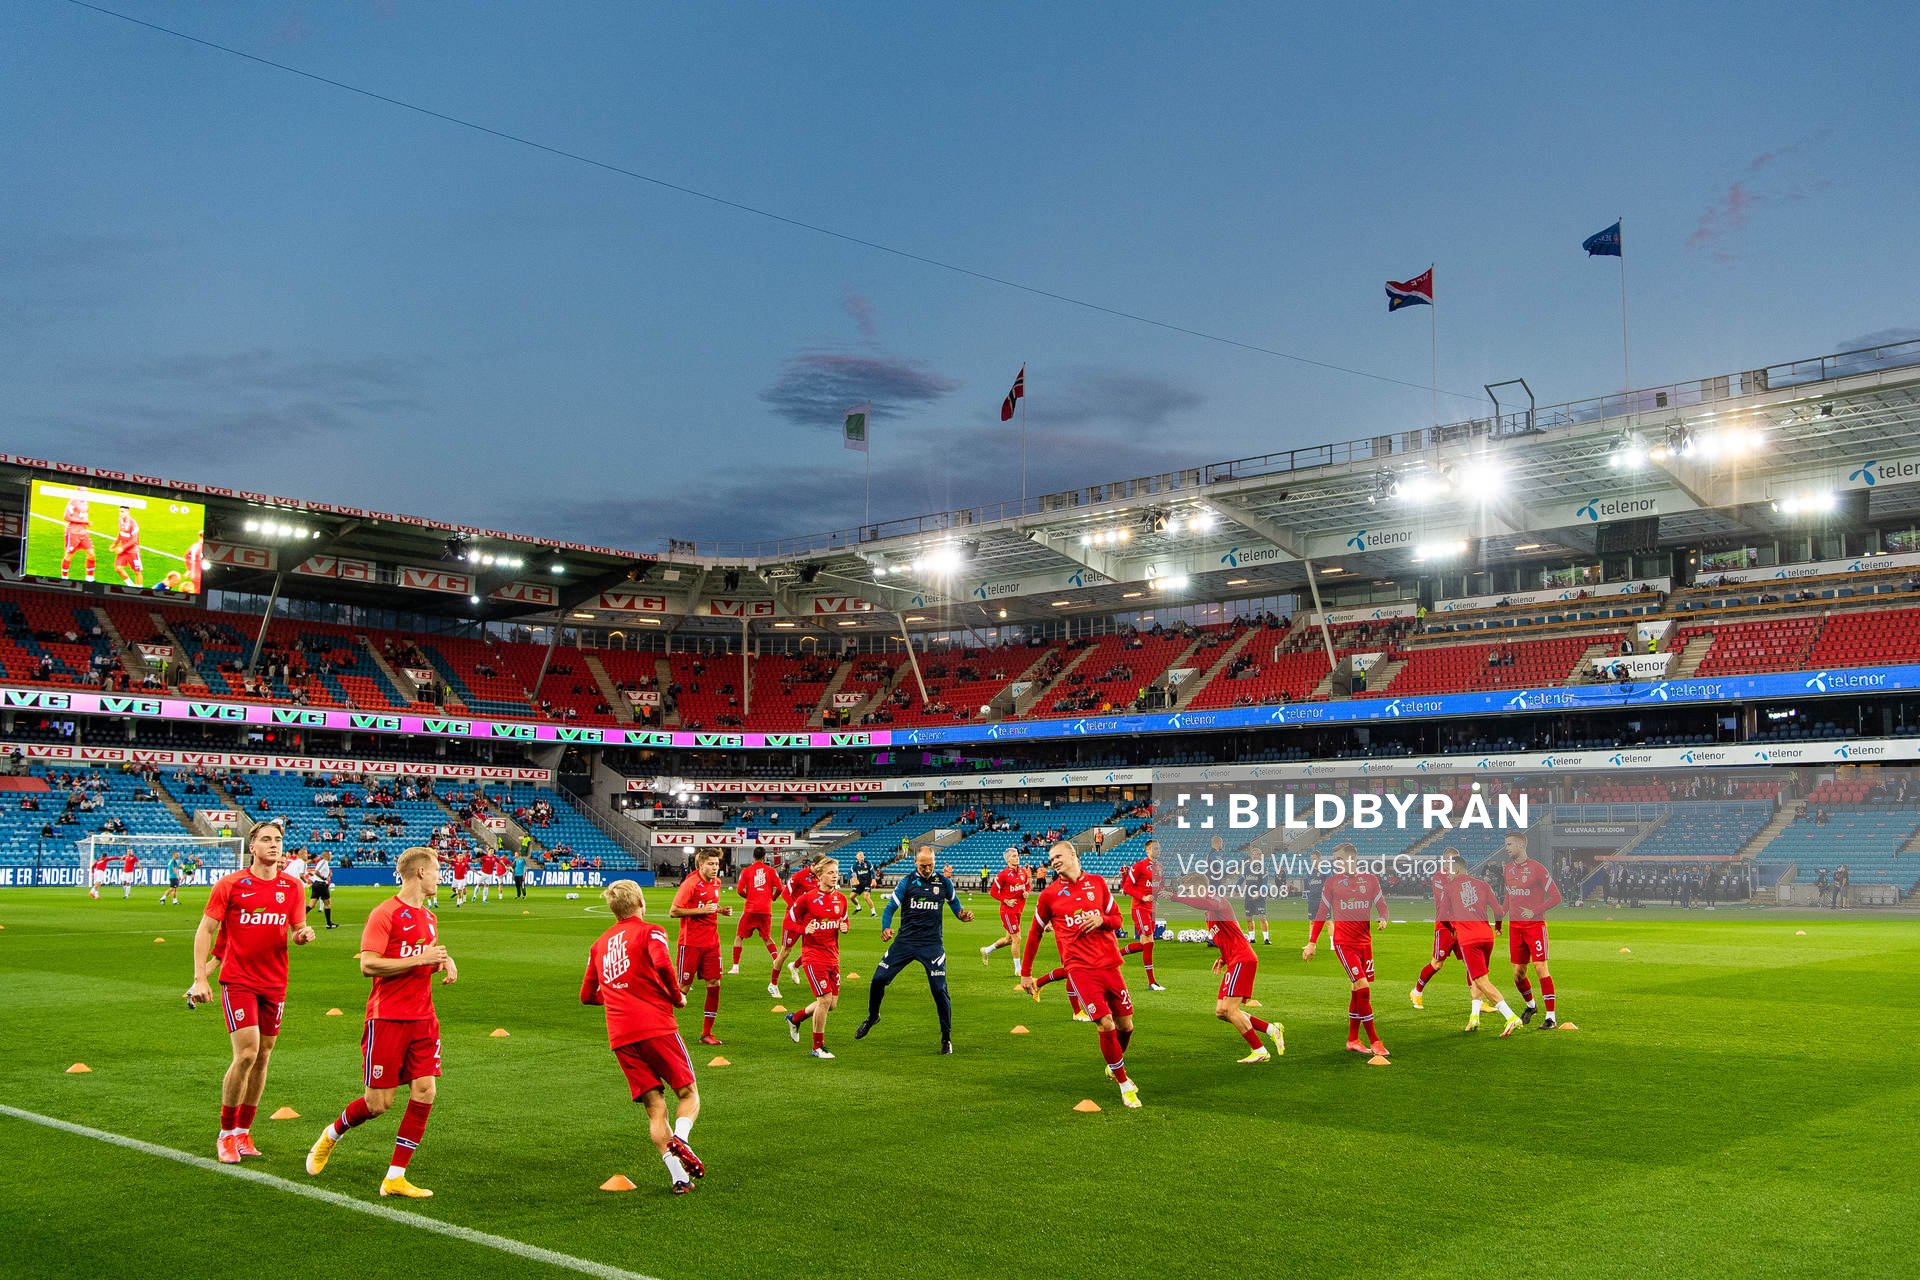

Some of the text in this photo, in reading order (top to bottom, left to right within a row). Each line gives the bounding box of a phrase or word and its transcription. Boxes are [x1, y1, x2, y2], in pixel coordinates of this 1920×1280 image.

[17, 457, 47, 467] VG
[56, 463, 87, 474] VG
[96, 469, 125, 480] VG
[134, 475, 161, 485] VG
[170, 480, 197, 491] VG
[206, 486, 232, 496] VG
[241, 492, 266, 501] VG
[274, 497, 299, 506] VG
[307, 502, 331, 511] VG
[339, 506, 362, 516] VG
[370, 511, 393, 521] VG
[400, 516, 422, 526] VG
[429, 521, 451, 530] VG
[458, 526, 479, 534] VG
[486, 530, 507, 538] VG
[513, 534, 534, 543] VG
[540, 538, 560, 547] VG
[565, 542, 586, 551] VG
[591, 546, 610, 555] VG
[615, 550, 634, 558] VG
[640, 553, 658, 562] VG
[1600, 497, 1656, 516] telenor
[1367, 530, 1413, 545] telenor
[204, 544, 267, 567] VG
[1239, 548, 1280, 562] telenor
[306, 556, 367, 580] VG
[1788, 567, 1819, 577] telenor
[1861, 560, 1894, 569] telenor
[407, 570, 466, 592] VG
[987, 583, 1020, 595] telenor
[500, 583, 551, 603] VG
[1453, 601, 1478, 610] telenor
[1568, 588, 1597, 599] telor
[1631, 583, 1659, 593] telor
[601, 593, 663, 611] VG
[712, 600, 772, 615] VG
[817, 597, 872, 613] VG
[1332, 609, 1404, 622] telenor telenor
[139, 646, 171, 656] VG
[1625, 660, 1666, 672] elenor
[629, 692, 657, 701] VG
[836, 694, 862, 703] VG
[1086, 721, 1117, 731] telenor
[1182, 714, 1216, 725] telenor
[1287, 707, 1324, 719] telenor
[1401, 700, 1443, 713] telenor
[1529, 692, 1574, 705] telenor
[1670, 682, 1722, 697] telenor
[1828, 673, 1886, 689] telenor
[6, 691, 869, 746] VG VG VG VG VG VG VG VG VG VG VG VG
[31, 746, 71, 757] VG
[83, 749, 123, 760] VG
[135, 751, 173, 762] VG
[183, 754, 221, 764] VG
[232, 756, 267, 766] VG
[277, 758, 312, 768] VG
[321, 760, 355, 770] VG
[364, 762, 396, 772] VG
[405, 765, 436, 774] VG
[444, 767, 475, 776] VG
[482, 768, 512, 777] VG
[519, 770, 548, 779] VG
[708, 783, 742, 792] VG
[746, 783, 781, 792] VG
[785, 783, 816, 792] VG
[821, 782, 851, 791] VG
[855, 782, 881, 791] VG
[1114, 773, 1133, 781] telenor
[1260, 768, 1282, 776] telenor
[1313, 766, 1336, 774] telenor
[1368, 764, 1393, 773] telenor
[1427, 761, 1453, 770] telenor
[1489, 758, 1516, 769] telenor
[1552, 757, 1583, 766] telenor
[1621, 754, 1652, 764] telenor
[1694, 751, 1725, 760] telenor
[1768, 748, 1803, 758] telenor
[1849, 746, 1885, 755] telenor
[203, 812, 237, 821] VG
[484, 819, 506, 828] VG
[658, 835, 791, 844] VG VG VG
[17, 868, 32, 885] ER
[38, 868, 84, 885] ENDELIG
[572, 871, 587, 885] KR.
[588, 871, 607, 887] 50,-
[910, 897, 939, 911] bama
[1340, 899, 1369, 910] bama
[240, 908, 287, 925] bama
[608, 930, 626, 951] EAT
[1536, 940, 1542, 951] 3
[400, 941, 428, 958] ba
[603, 940, 628, 969] MOVE
[603, 959, 631, 984] SLEEP
